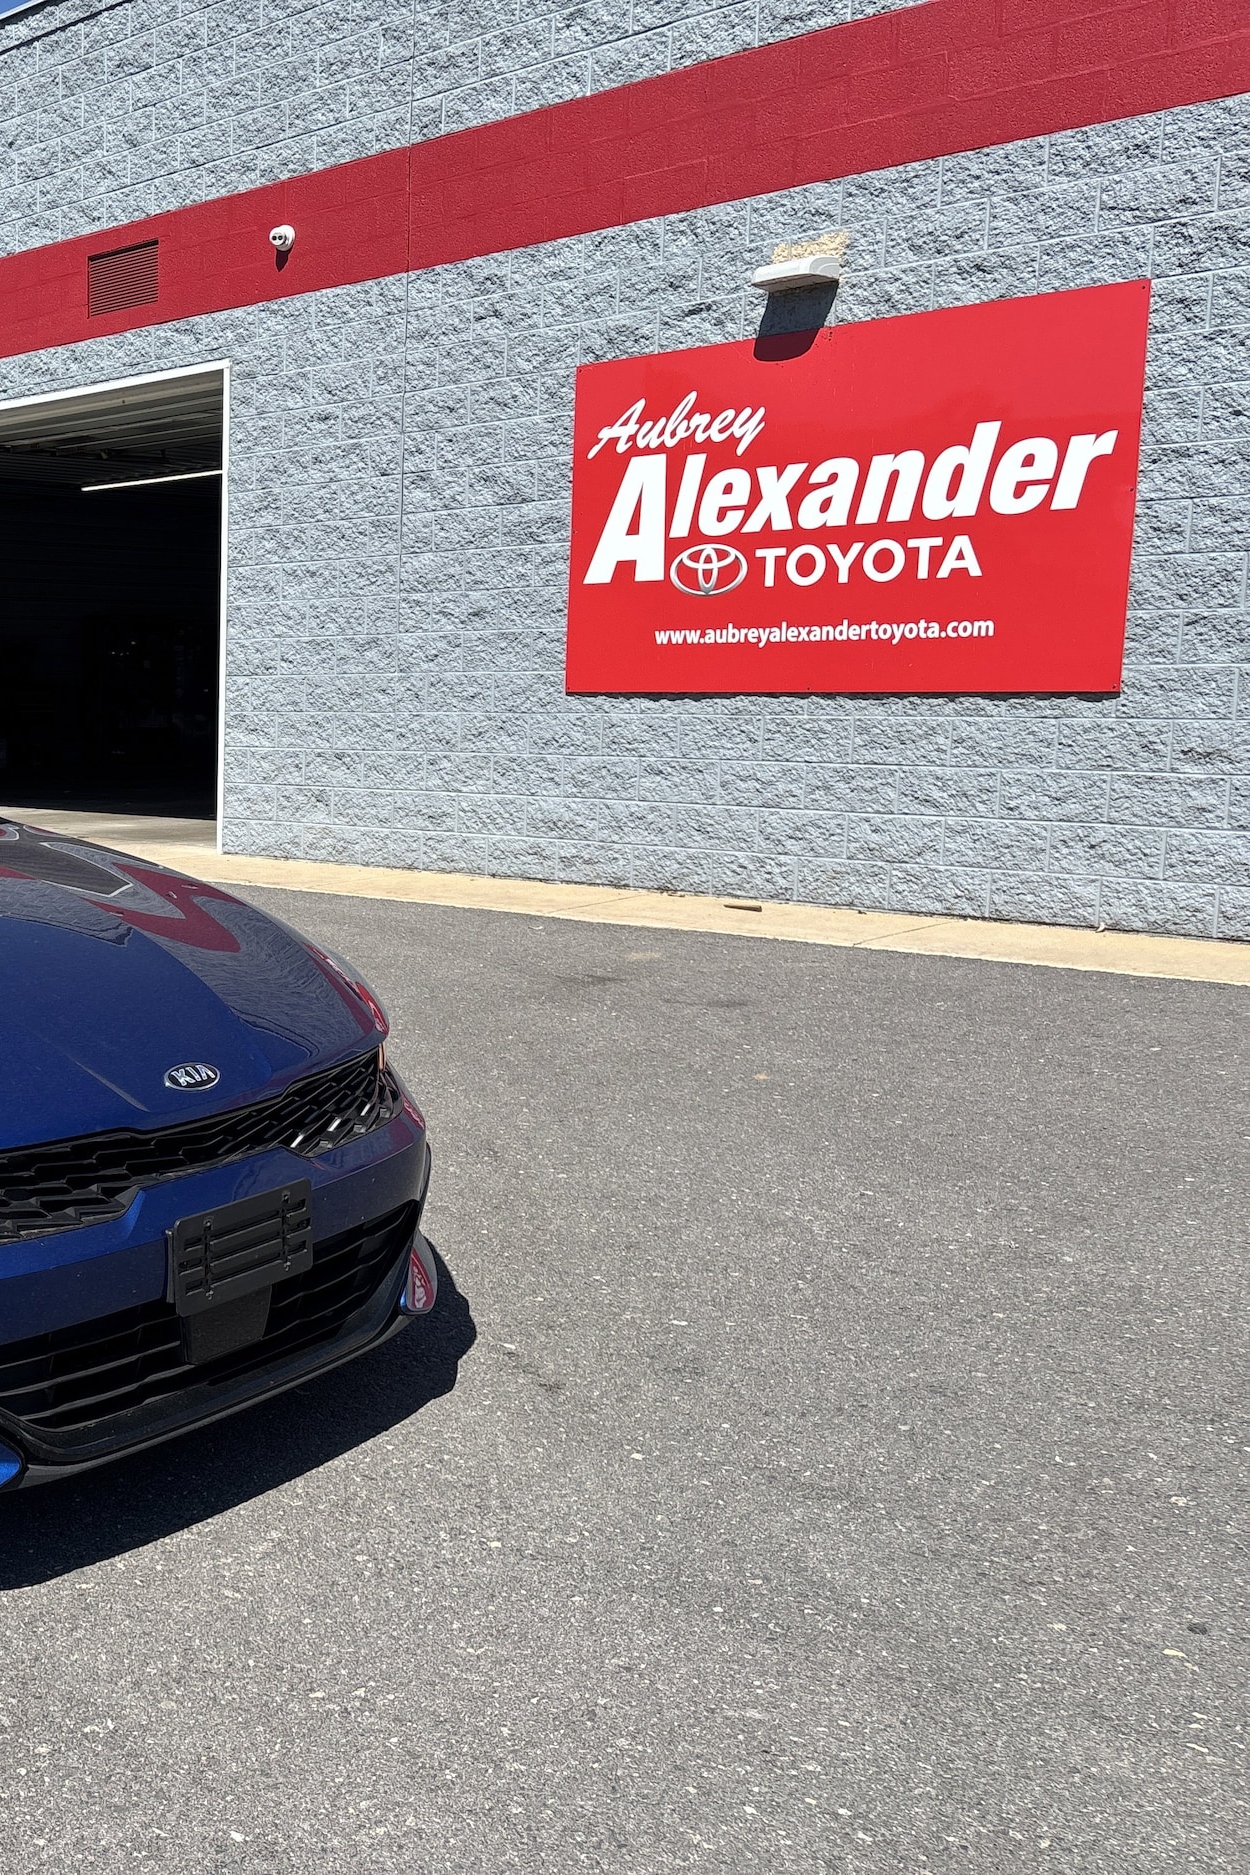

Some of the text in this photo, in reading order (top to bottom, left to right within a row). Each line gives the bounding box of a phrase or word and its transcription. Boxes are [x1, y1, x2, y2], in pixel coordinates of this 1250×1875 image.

[587, 390, 766, 460] Aubrey
[582, 420, 1119, 585] Alexander
[755, 534, 983, 588] TOYOTA
[654, 619, 995, 649] www.aubreyalexandertoyota.com
[170, 1064, 216, 1087] KIA
